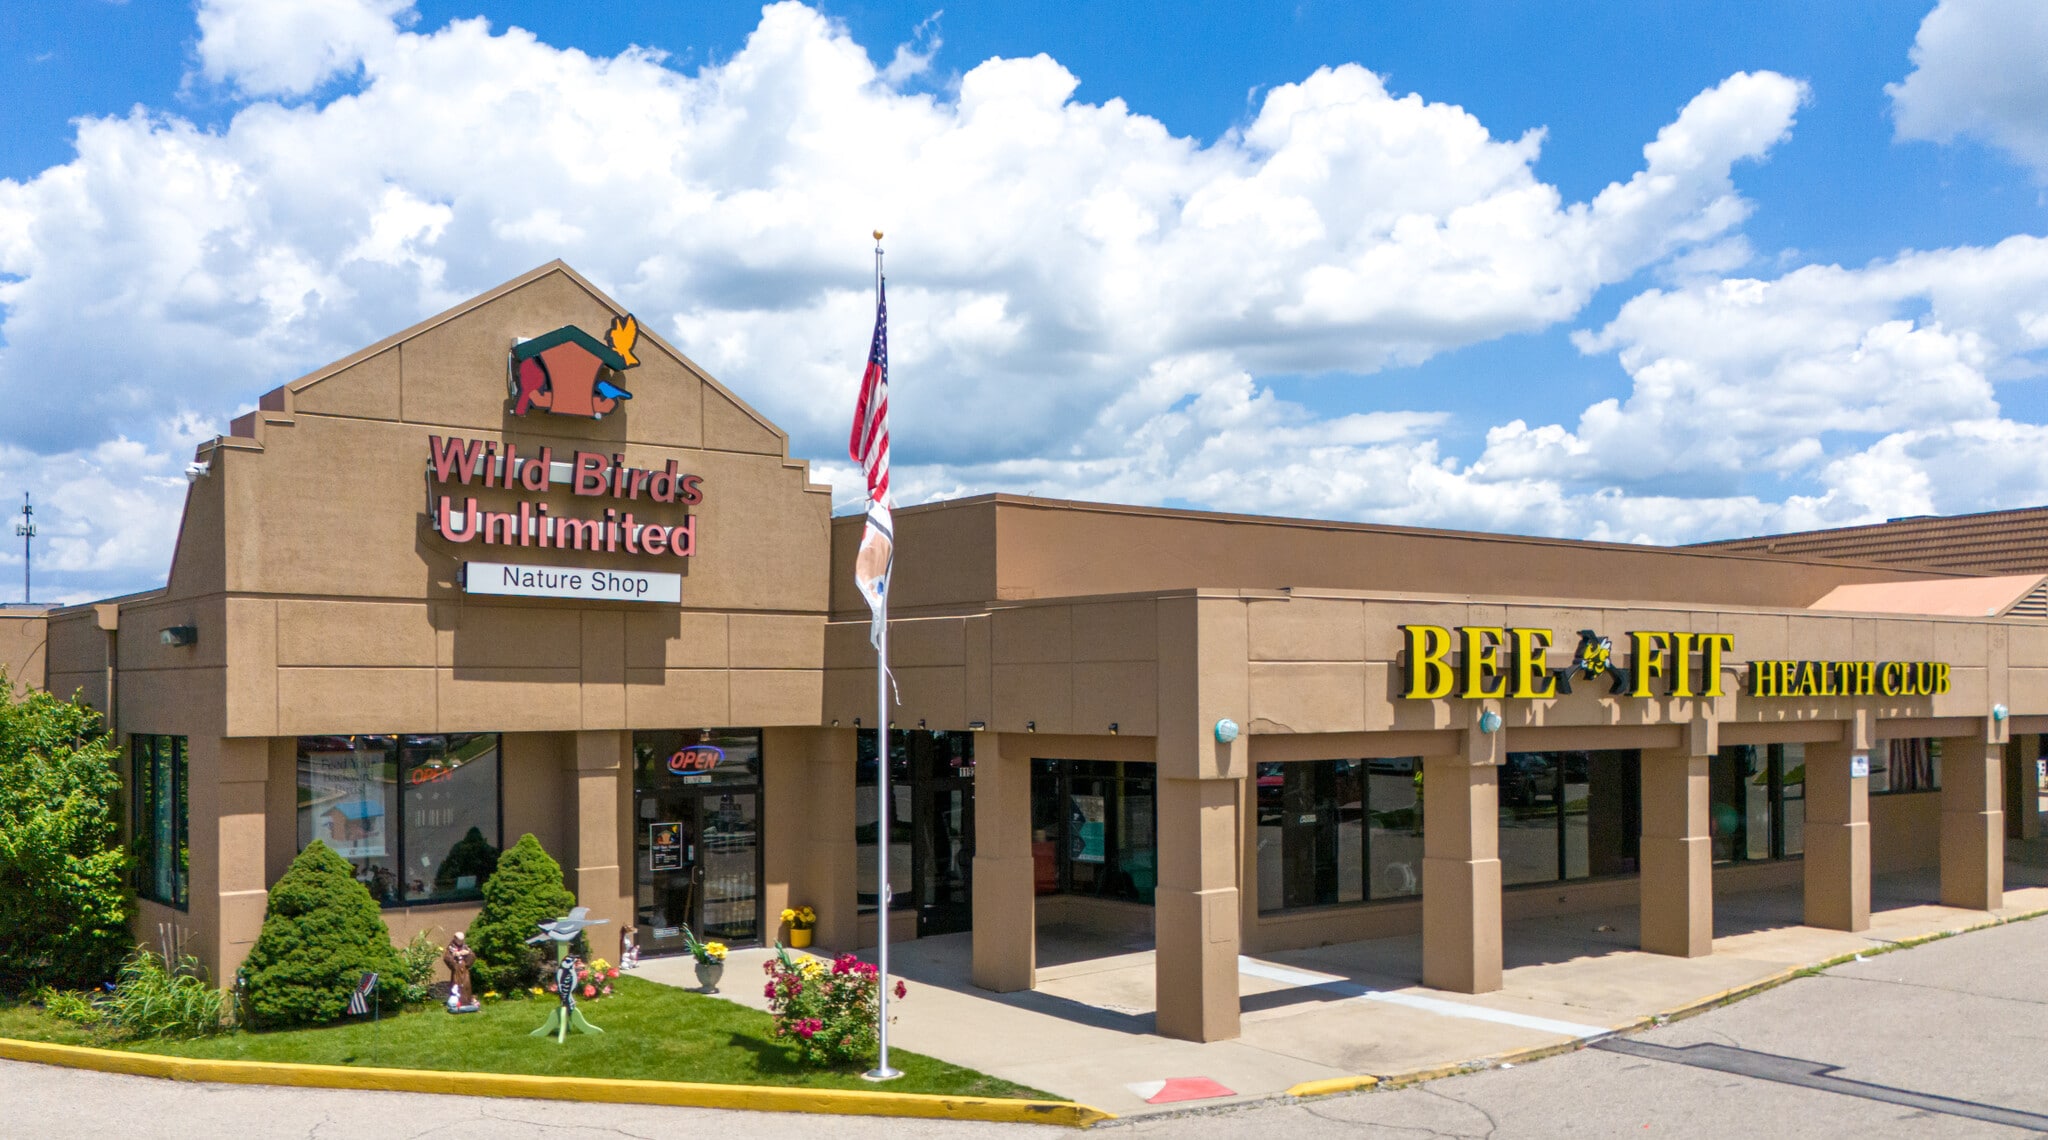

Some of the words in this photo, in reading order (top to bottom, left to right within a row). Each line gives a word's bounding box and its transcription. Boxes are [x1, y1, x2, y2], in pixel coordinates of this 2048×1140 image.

[429, 435, 552, 492] Wild
[573, 450, 704, 506] Birds
[438, 495, 697, 557] Unlimited
[503, 566, 582, 590] Nature
[591, 572, 649, 597] Shop
[1399, 624, 1557, 700] BEE
[1626, 630, 1735, 698] FIT
[1746, 660, 1876, 698] HEALTH
[1876, 661, 1952, 697] CLUB
[412, 768, 453, 785] OPEN
[671, 751, 719, 769] OPEN
